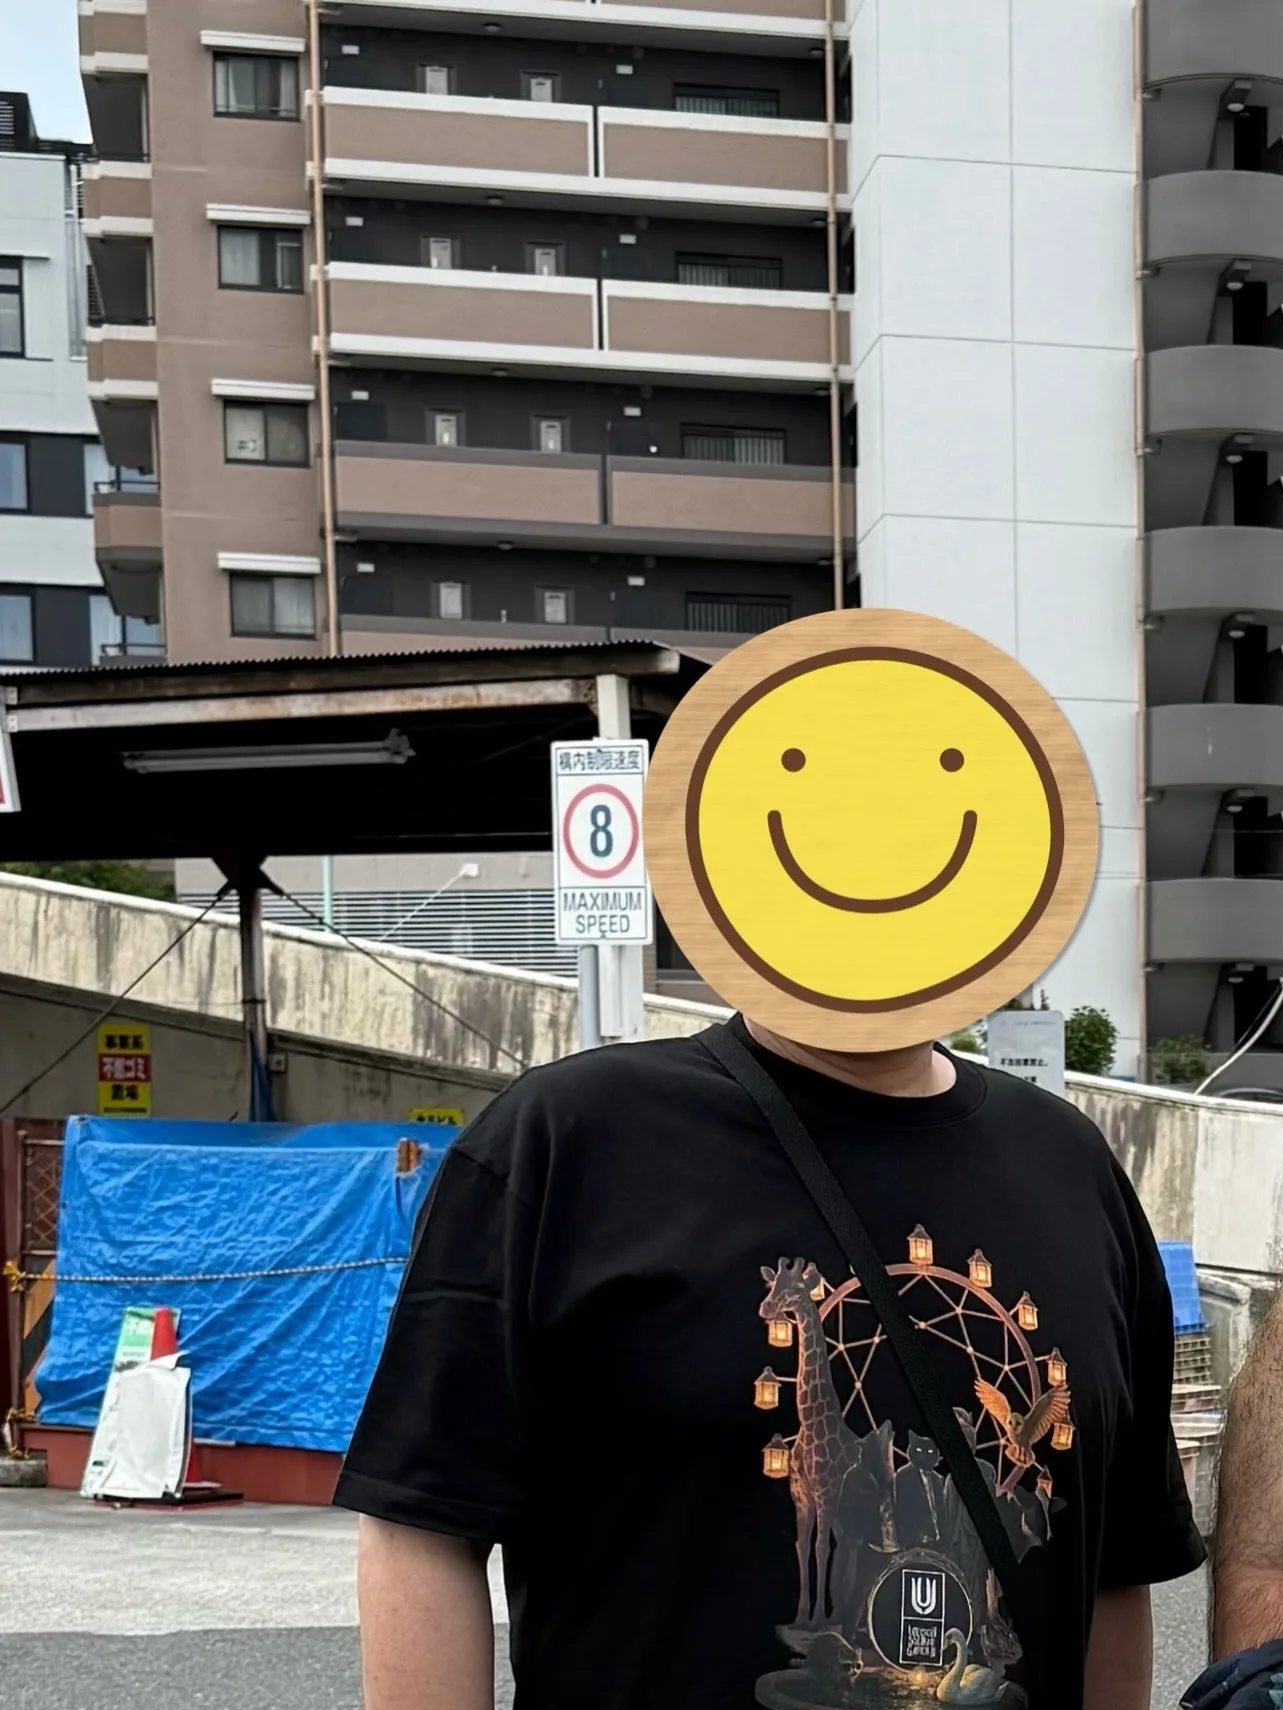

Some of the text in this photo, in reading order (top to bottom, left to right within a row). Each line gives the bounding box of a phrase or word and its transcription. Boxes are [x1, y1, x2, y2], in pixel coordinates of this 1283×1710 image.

[589, 804, 613, 858] 8
[563, 892, 642, 912] MAXIMUM
[576, 914, 630, 934] SPEED
